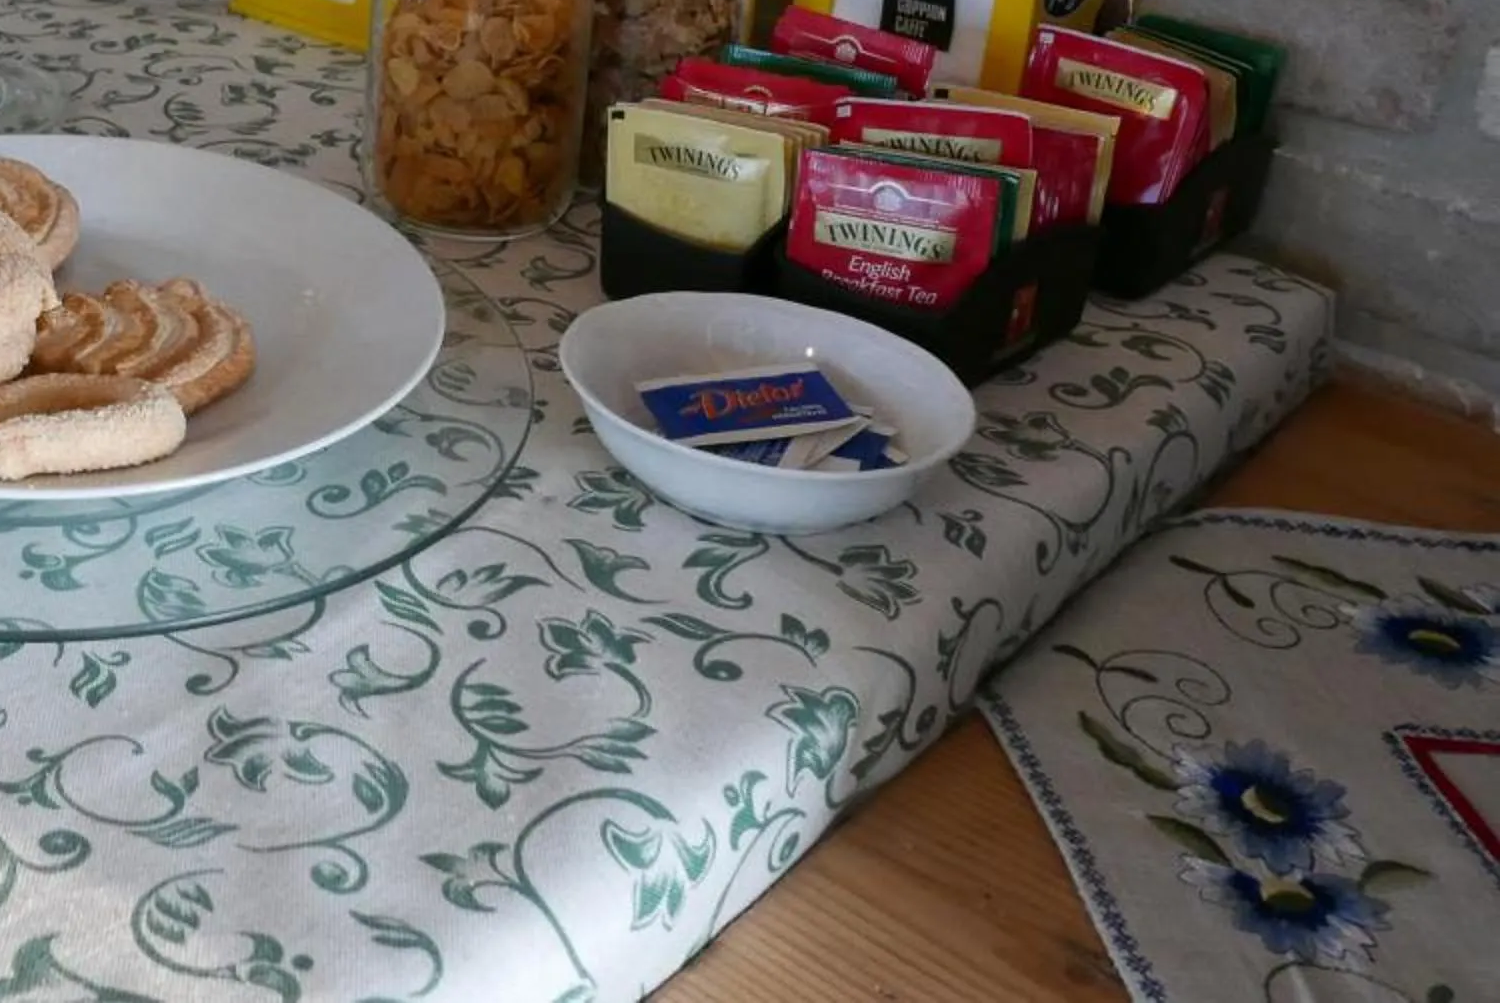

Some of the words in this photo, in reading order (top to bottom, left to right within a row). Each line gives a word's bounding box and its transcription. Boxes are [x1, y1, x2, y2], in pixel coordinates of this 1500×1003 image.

[1068, 70, 1157, 111] TWININGS
[649, 144, 742, 181] TWININGS
[826, 223, 946, 260] TWININGS
[848, 255, 912, 282] English
[908, 285, 938, 305] Tea
